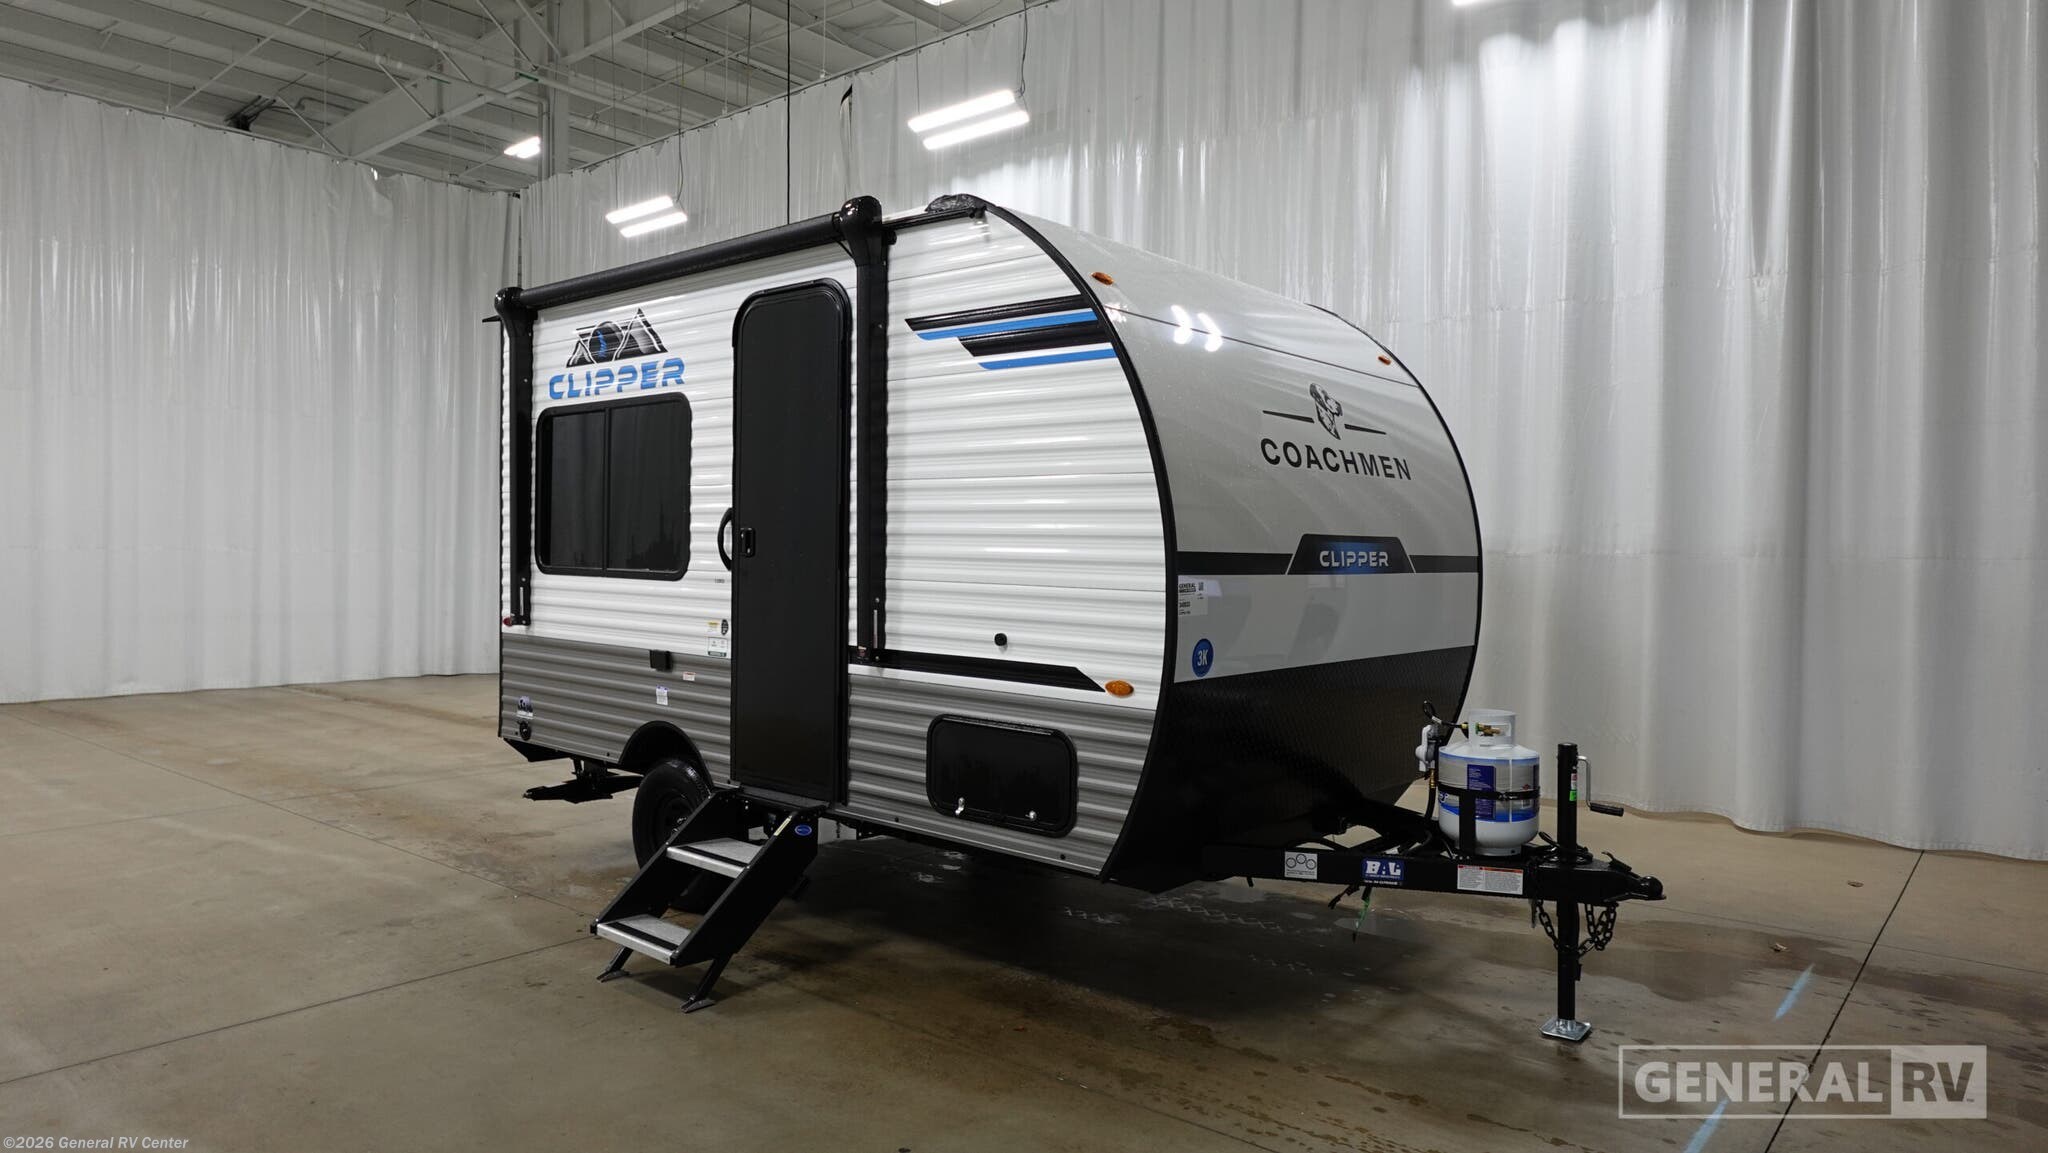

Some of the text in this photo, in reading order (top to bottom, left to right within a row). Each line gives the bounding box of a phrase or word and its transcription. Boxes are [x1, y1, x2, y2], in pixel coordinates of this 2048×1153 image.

[549, 358, 685, 400] CLIPPER
[1260, 438, 1412, 481] COACHMEN
[1319, 550, 1389, 568] CLIPPER
[1197, 649, 1209, 666] 3K
[1365, 861, 1402, 876] BAL
